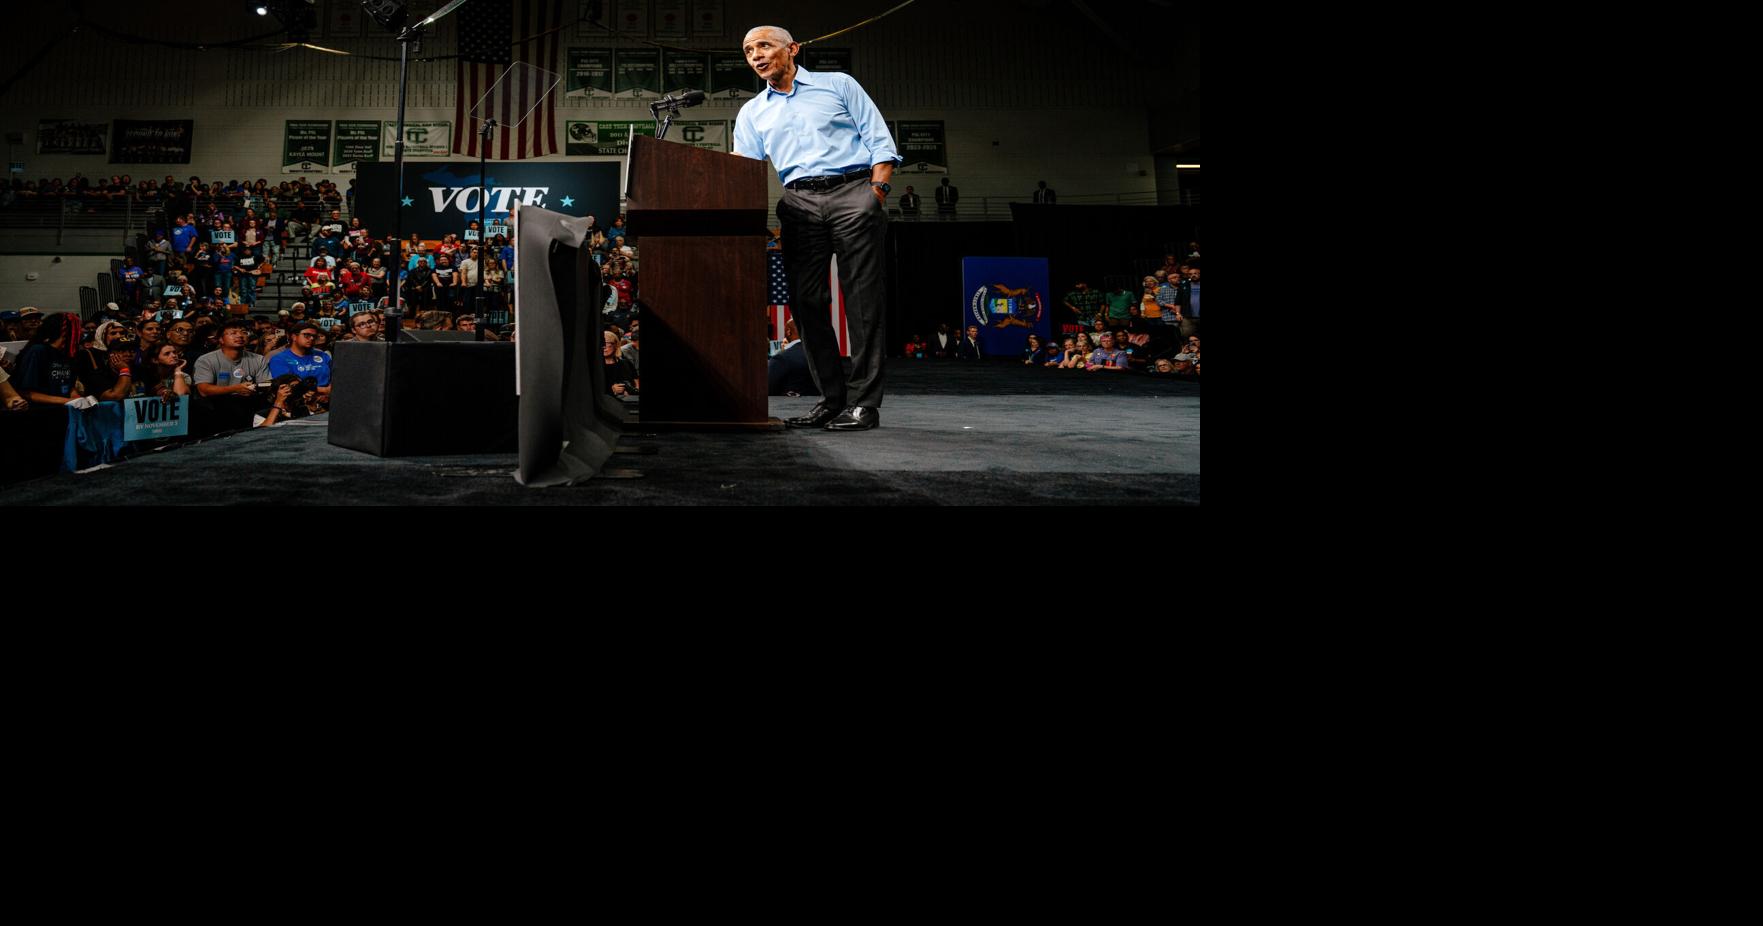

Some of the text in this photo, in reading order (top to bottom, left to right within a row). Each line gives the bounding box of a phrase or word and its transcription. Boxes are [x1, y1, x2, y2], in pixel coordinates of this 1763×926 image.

[428, 186, 549, 213] VOTE
[488, 226, 504, 234] VOTE
[214, 231, 232, 239] VOTE
[352, 303, 372, 312] VOTE
[134, 397, 180, 423] VOTE
